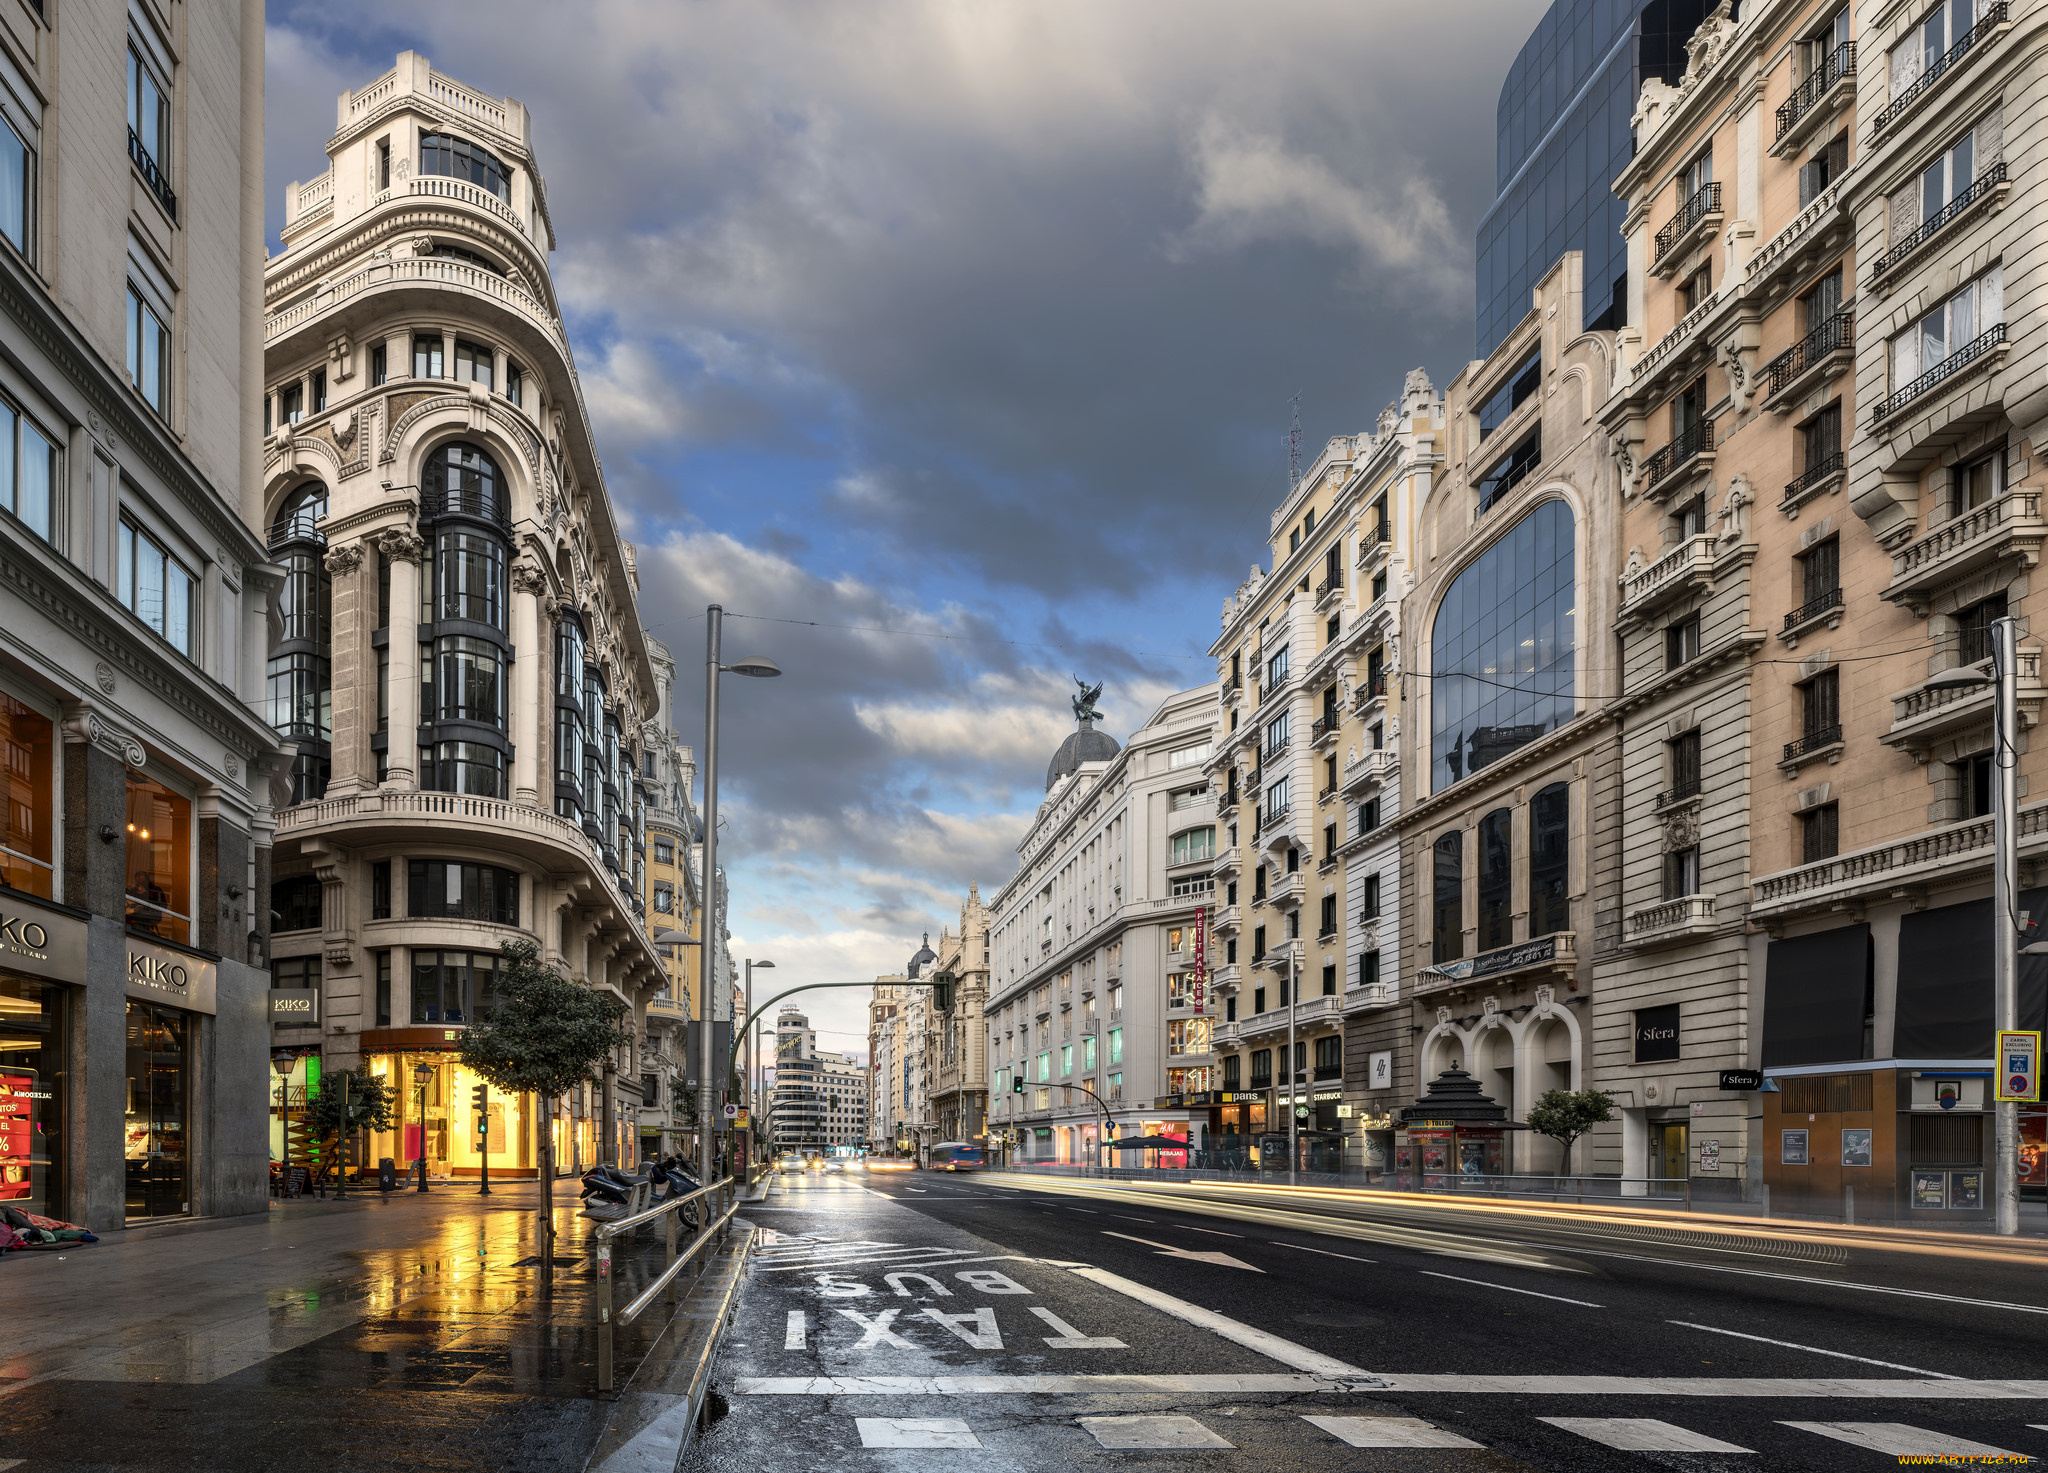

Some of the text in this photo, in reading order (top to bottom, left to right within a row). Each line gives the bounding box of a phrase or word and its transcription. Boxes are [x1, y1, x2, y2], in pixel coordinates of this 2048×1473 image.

[128, 951, 187, 987] KIKO
[274, 999, 310, 1009] KIKO
[1643, 1027, 1675, 1041] Sfera
[1728, 1076, 1752, 1084] Sfera
[1233, 1092, 1258, 1102] pans
[814, 1270, 1034, 1297] BUS
[784, 1307, 1130, 1349] TAXI
